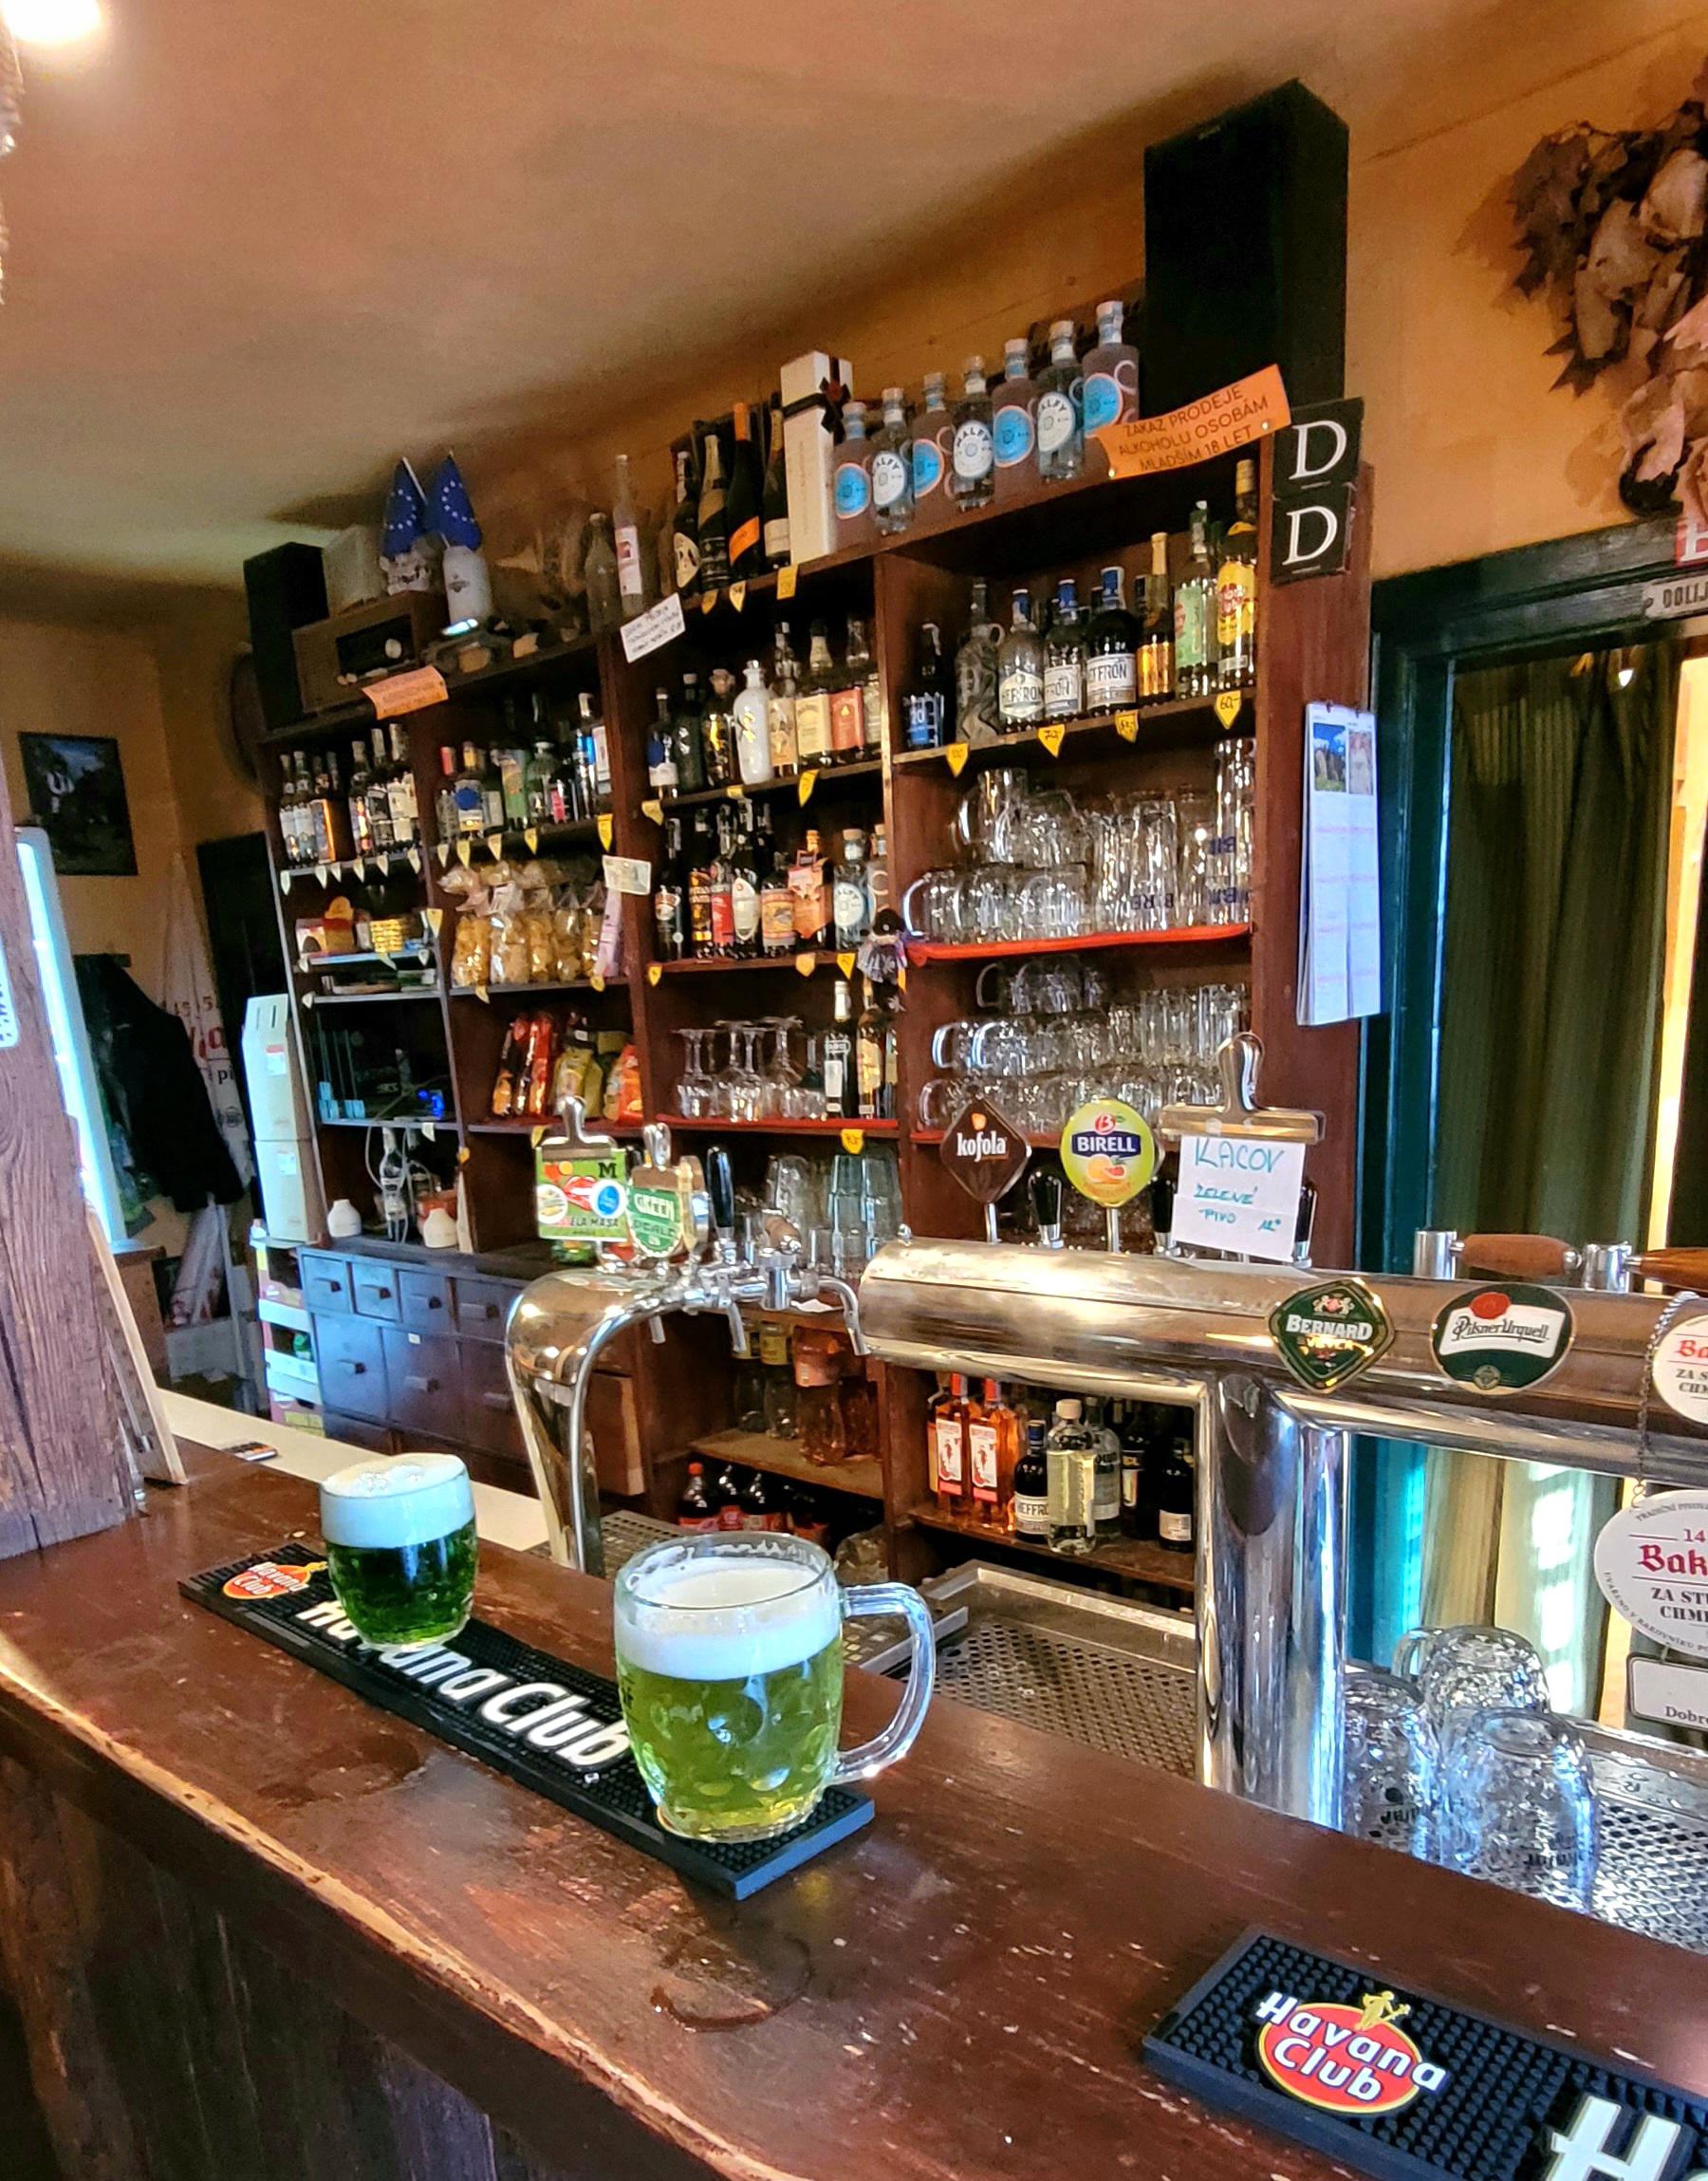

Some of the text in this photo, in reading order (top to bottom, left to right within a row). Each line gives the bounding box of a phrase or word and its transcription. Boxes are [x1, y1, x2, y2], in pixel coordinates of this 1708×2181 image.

[1169, 384, 1243, 426] PRODEJE
[1119, 396, 1269, 456] ALKOHOLU OSOBÁM
[1204, 440, 1219, 456] 18
[1224, 424, 1253, 449] LET
[1288, 420, 1347, 479] D
[1282, 505, 1338, 566] D
[956, 1130, 1006, 1162] kofola
[1077, 1136, 1137, 1152] BIRELL
[598, 1163, 617, 1178] M
[1286, 1314, 1373, 1340] BERNARD
[1451, 1315, 1550, 1342] Pilsner Urquell
[1676, 1369, 1694, 1380] ZA
[233, 1575, 274, 1595] Club
[248, 1561, 310, 1593] Havana
[1651, 1587, 1674, 1601] ZA
[480, 1681, 632, 1766] Club
[1665, 1706, 1708, 1724] Dobr
[1256, 1991, 1450, 2094] Havana
[1272, 2037, 1383, 2103] Club
